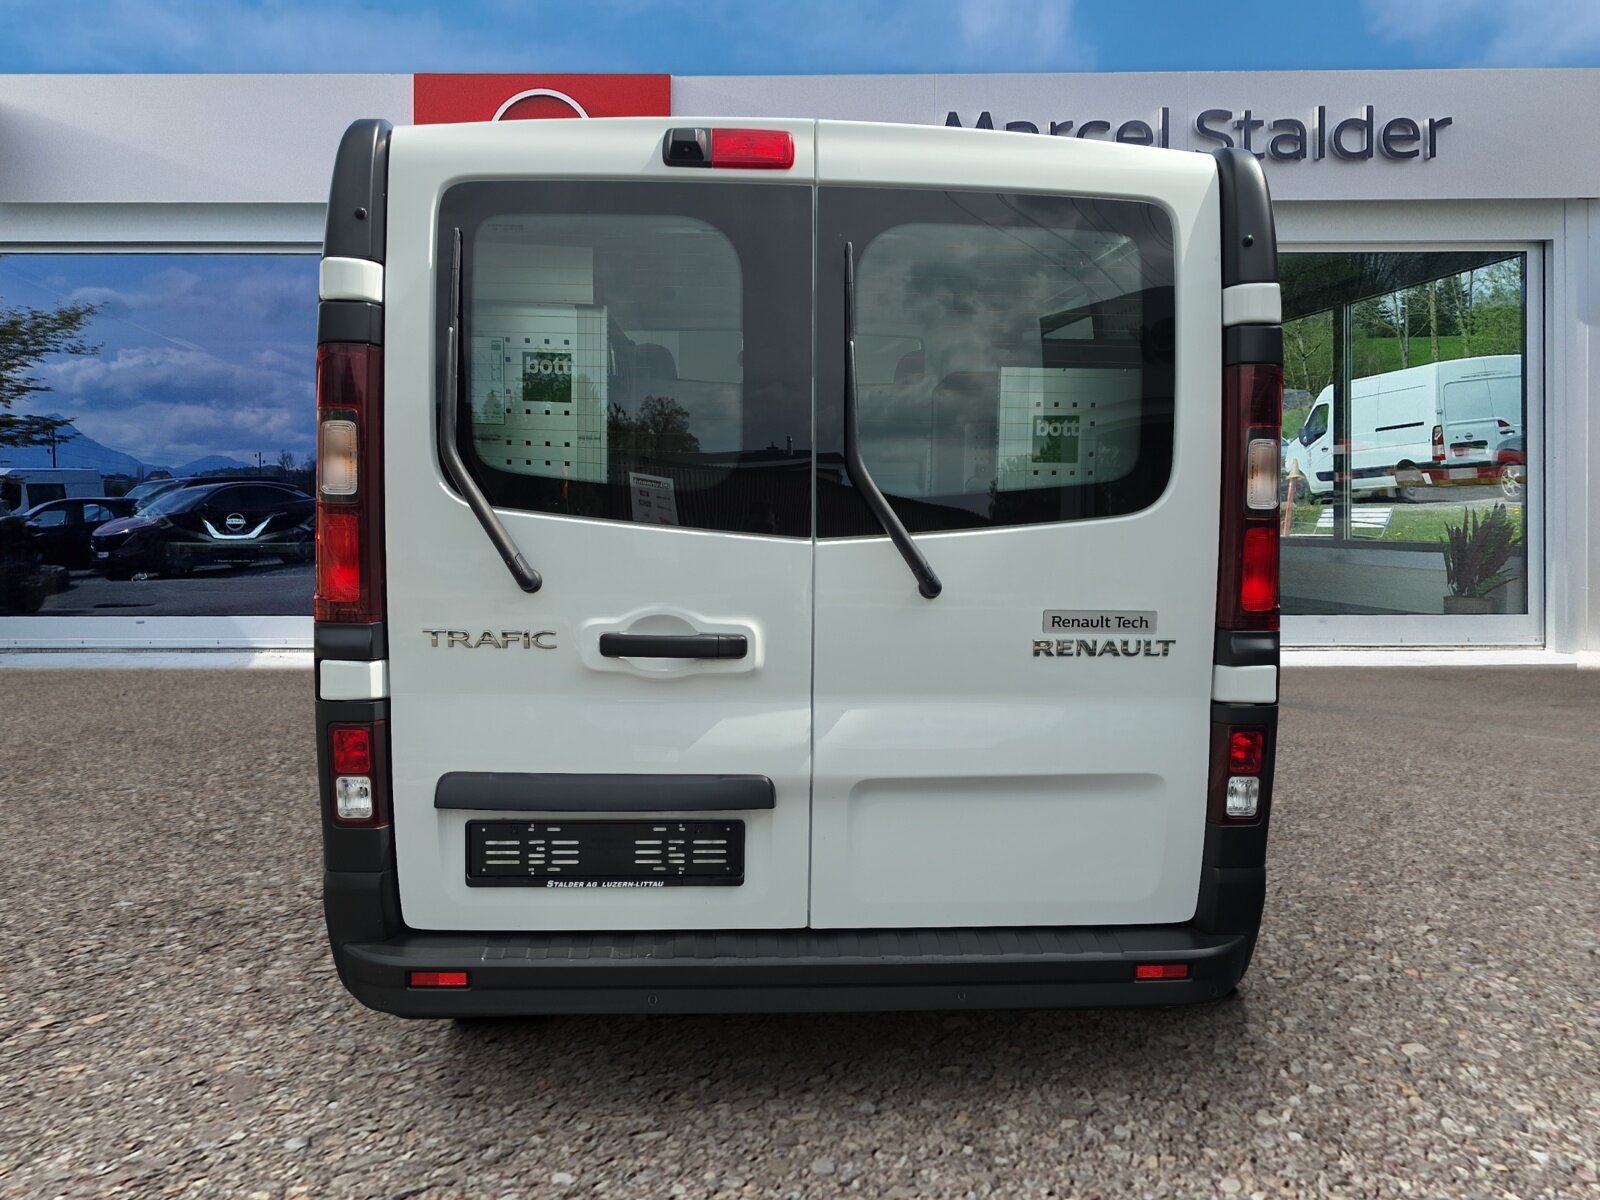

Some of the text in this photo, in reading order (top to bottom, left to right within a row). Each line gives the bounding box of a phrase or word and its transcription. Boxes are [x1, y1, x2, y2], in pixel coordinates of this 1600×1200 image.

[1196, 105, 1453, 160] Stalder
[525, 356, 571, 374] bott
[1036, 419, 1080, 436] bott
[1051, 615, 1149, 629] Renault Tech
[423, 629, 558, 650] TRAFIC
[1032, 639, 1177, 657] RENAULT
[546, 880, 585, 888] STALDER
